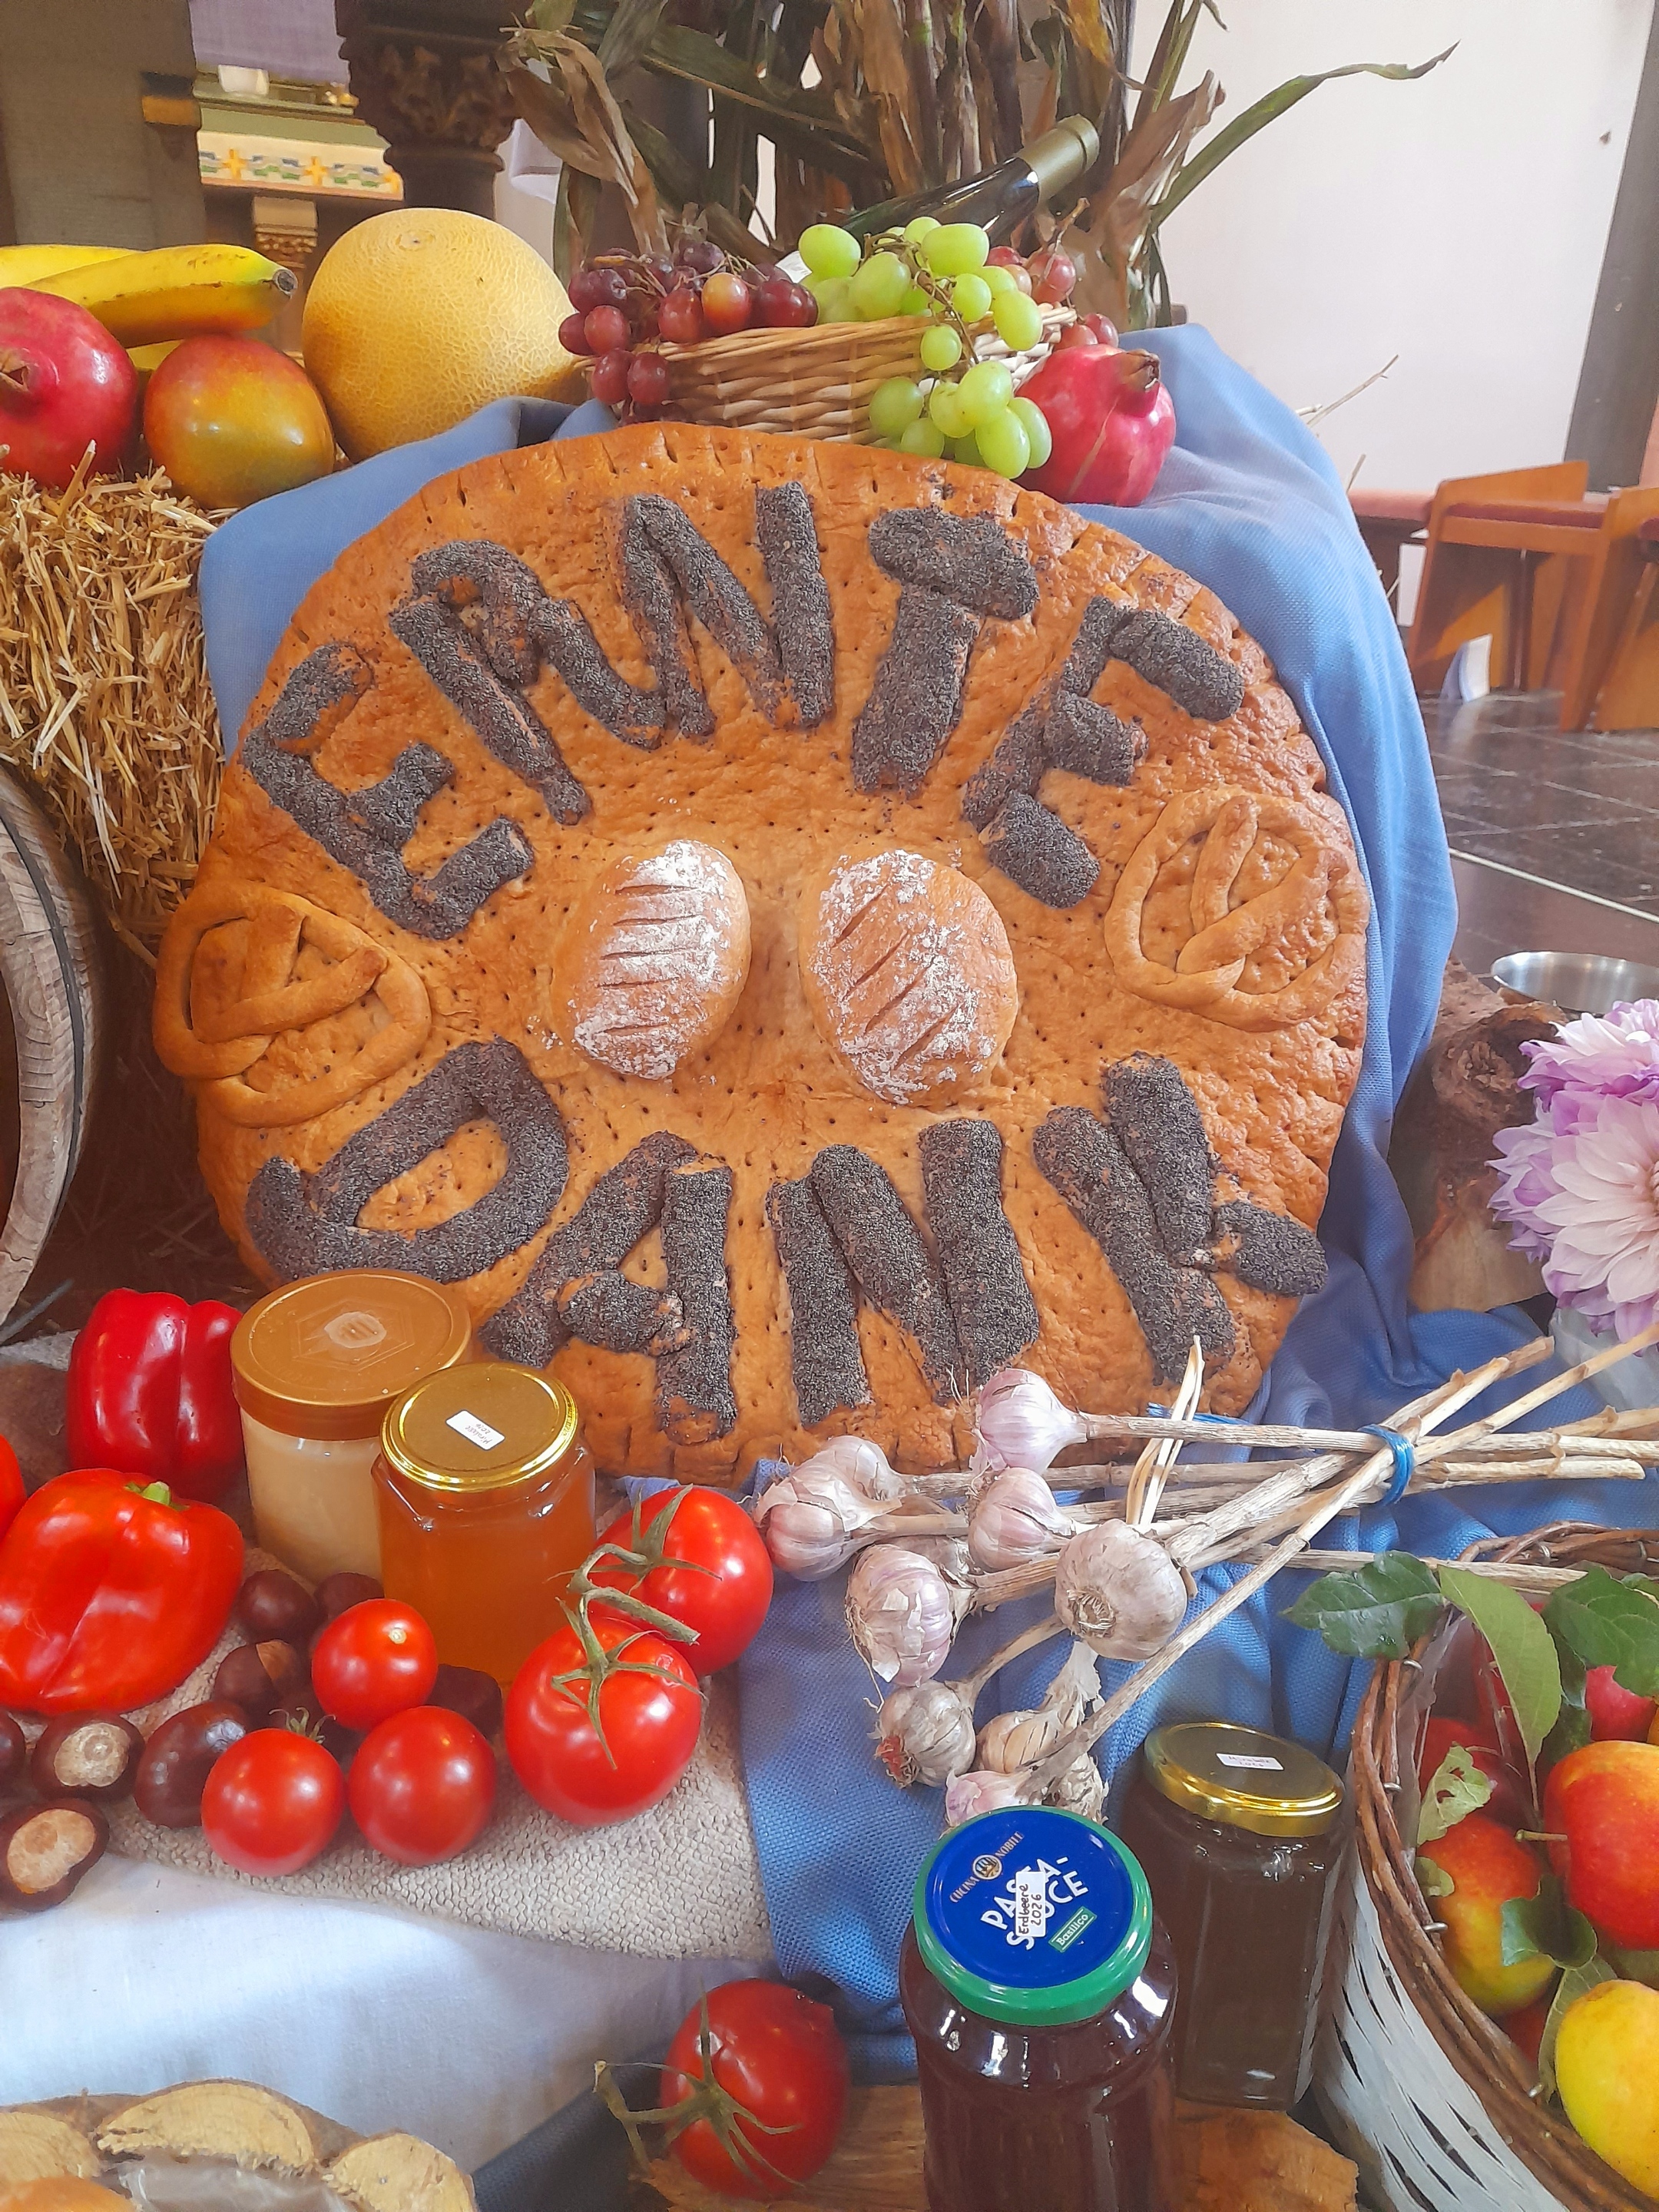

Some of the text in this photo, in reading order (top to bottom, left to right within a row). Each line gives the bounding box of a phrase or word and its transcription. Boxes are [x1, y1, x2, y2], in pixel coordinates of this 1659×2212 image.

[242, 482, 1244, 940] ERNTE
[245, 1035, 1328, 1445] DANK
[949, 1876, 980, 1902] CUCINA
[1018, 1883, 1030, 1935] Erdbeere
[1031, 1894, 1042, 1926] 2026
[1055, 1913, 1089, 1947] Basilico
